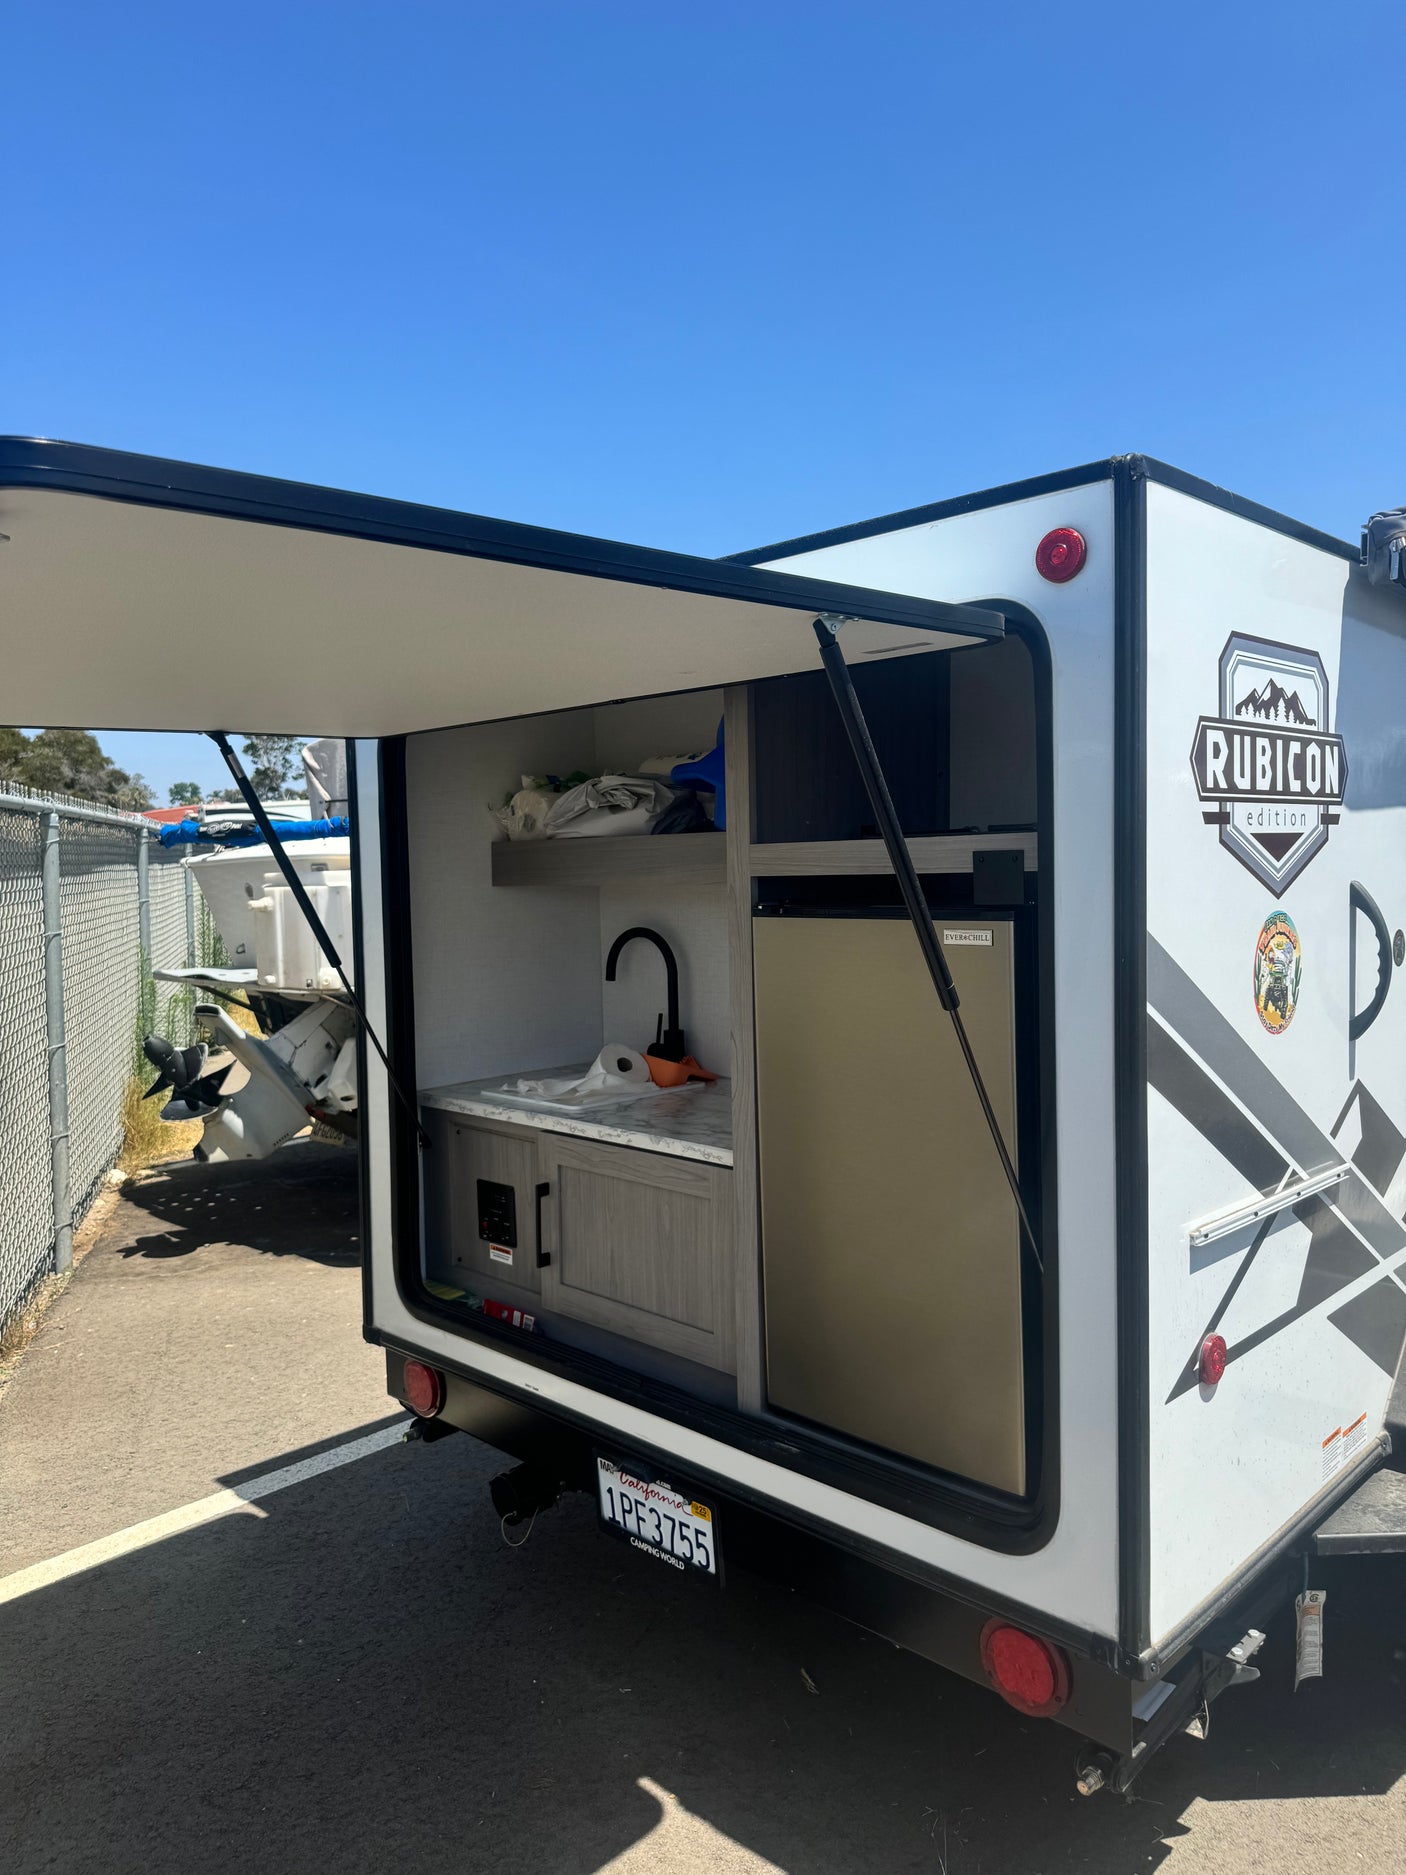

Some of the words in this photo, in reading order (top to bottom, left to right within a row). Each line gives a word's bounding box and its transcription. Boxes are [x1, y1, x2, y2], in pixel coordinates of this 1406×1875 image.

[1206, 728, 1339, 796] RUBICON
[1246, 807, 1307, 827] edition
[619, 1471, 693, 1516] California
[606, 1486, 711, 1571] 1PF3755
[629, 1536, 660, 1558] CAMPING
[659, 1550, 685, 1571] WORLD
